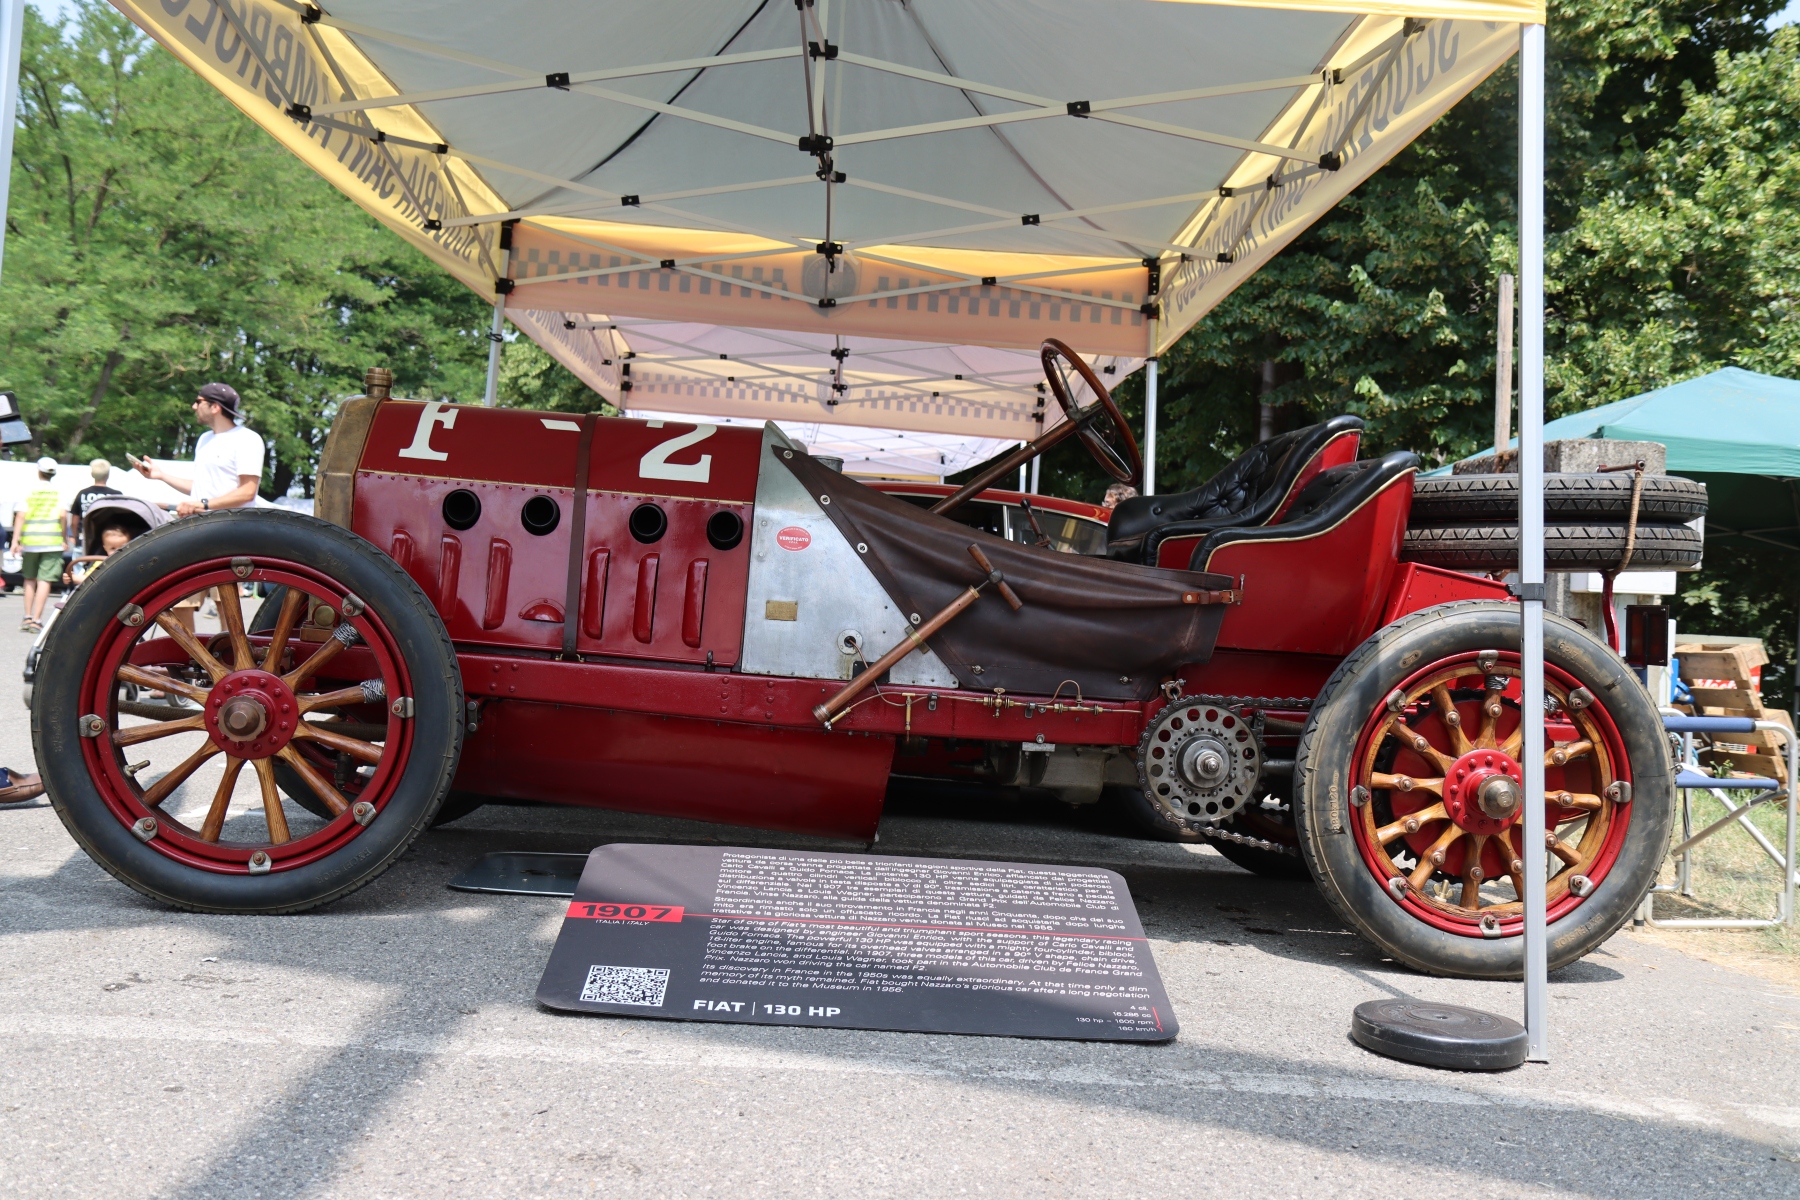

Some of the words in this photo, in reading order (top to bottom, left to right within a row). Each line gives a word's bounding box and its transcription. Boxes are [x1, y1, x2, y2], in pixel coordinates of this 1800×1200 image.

[315, 846, 372, 884] EXCELSIOR
[582, 904, 672, 920] 1907
[753, 926, 799, 934] designed
[1553, 912, 1606, 950] EXCELSIOR
[996, 945, 1031, 953] mighty
[798, 959, 833, 967] driving
[971, 962, 1030, 970] Automobile
[718, 964, 768, 973] discovery
[693, 1000, 746, 1012] FIAT
[764, 1004, 802, 1016] 130
[808, 1006, 841, 1018] HP
